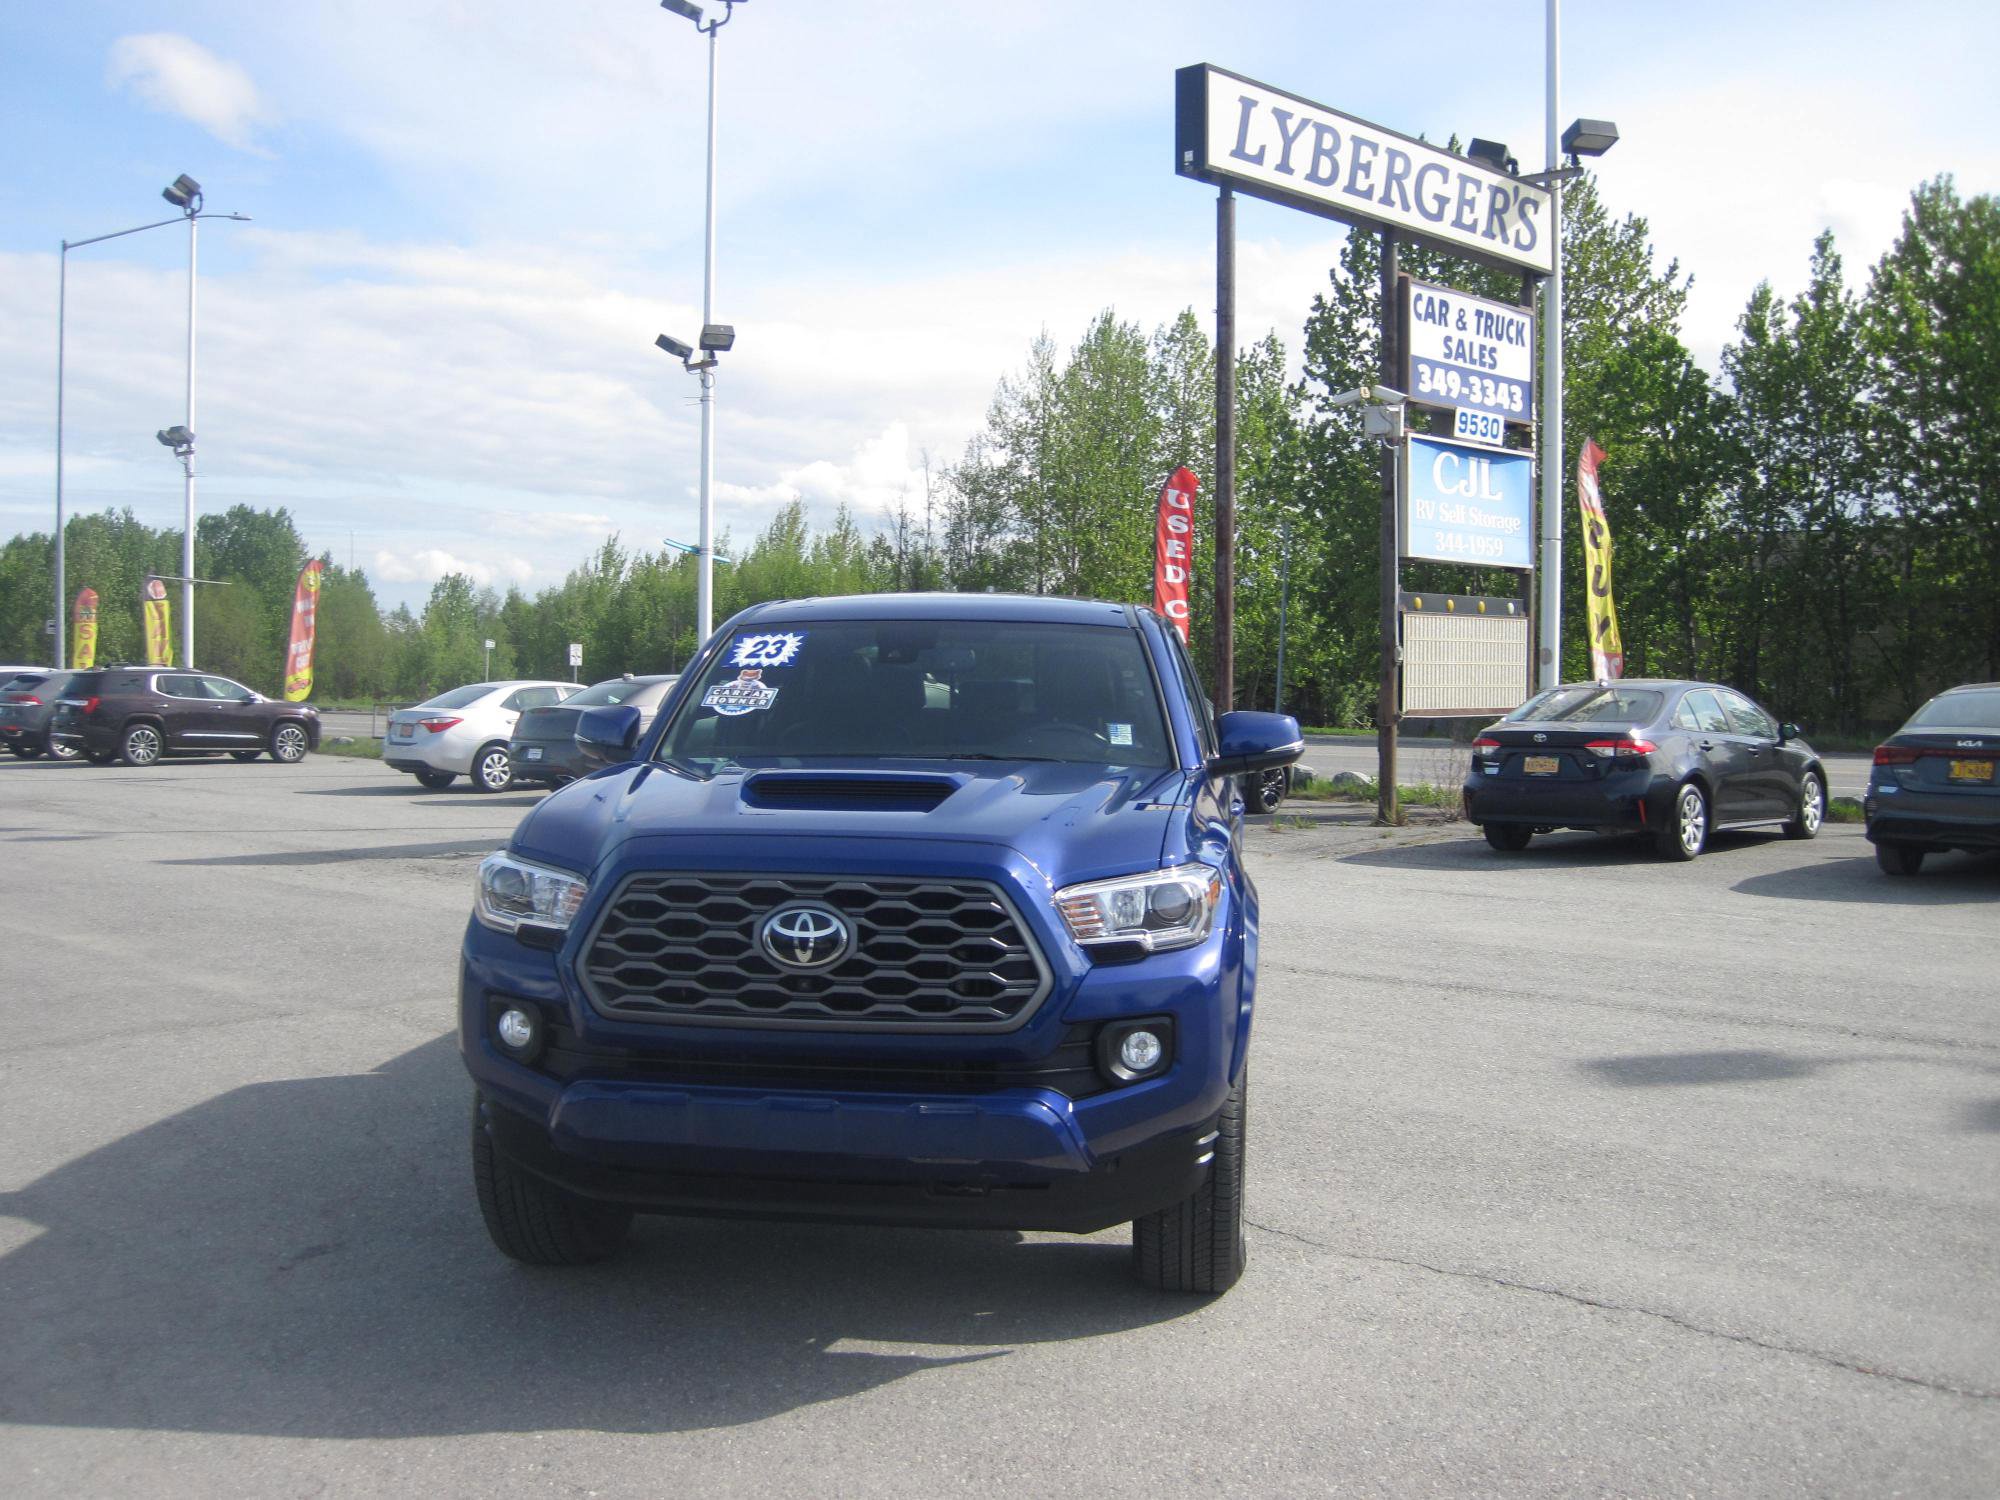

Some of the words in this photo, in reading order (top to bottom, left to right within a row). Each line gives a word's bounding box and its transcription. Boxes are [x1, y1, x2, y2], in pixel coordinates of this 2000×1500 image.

[1229, 95, 1540, 253] LYBERGER'S
[1413, 293, 1450, 328] CAR
[1455, 307, 1468, 332] &
[1474, 308, 1526, 348] TRUCK
[1442, 335, 1498, 371] SALES
[1416, 363, 1524, 413] 349-3343
[1457, 411, 1501, 441] 9530
[1432, 451, 1504, 501] CJL
[1416, 498, 1436, 521] RV
[1439, 502, 1467, 525] Self
[1468, 506, 1522, 535] Storage
[1165, 488, 1191, 584] USED
[1434, 530, 1504, 558] 344-1959
[744, 639, 787, 659] 23
[712, 688, 773, 699] CARFAX
